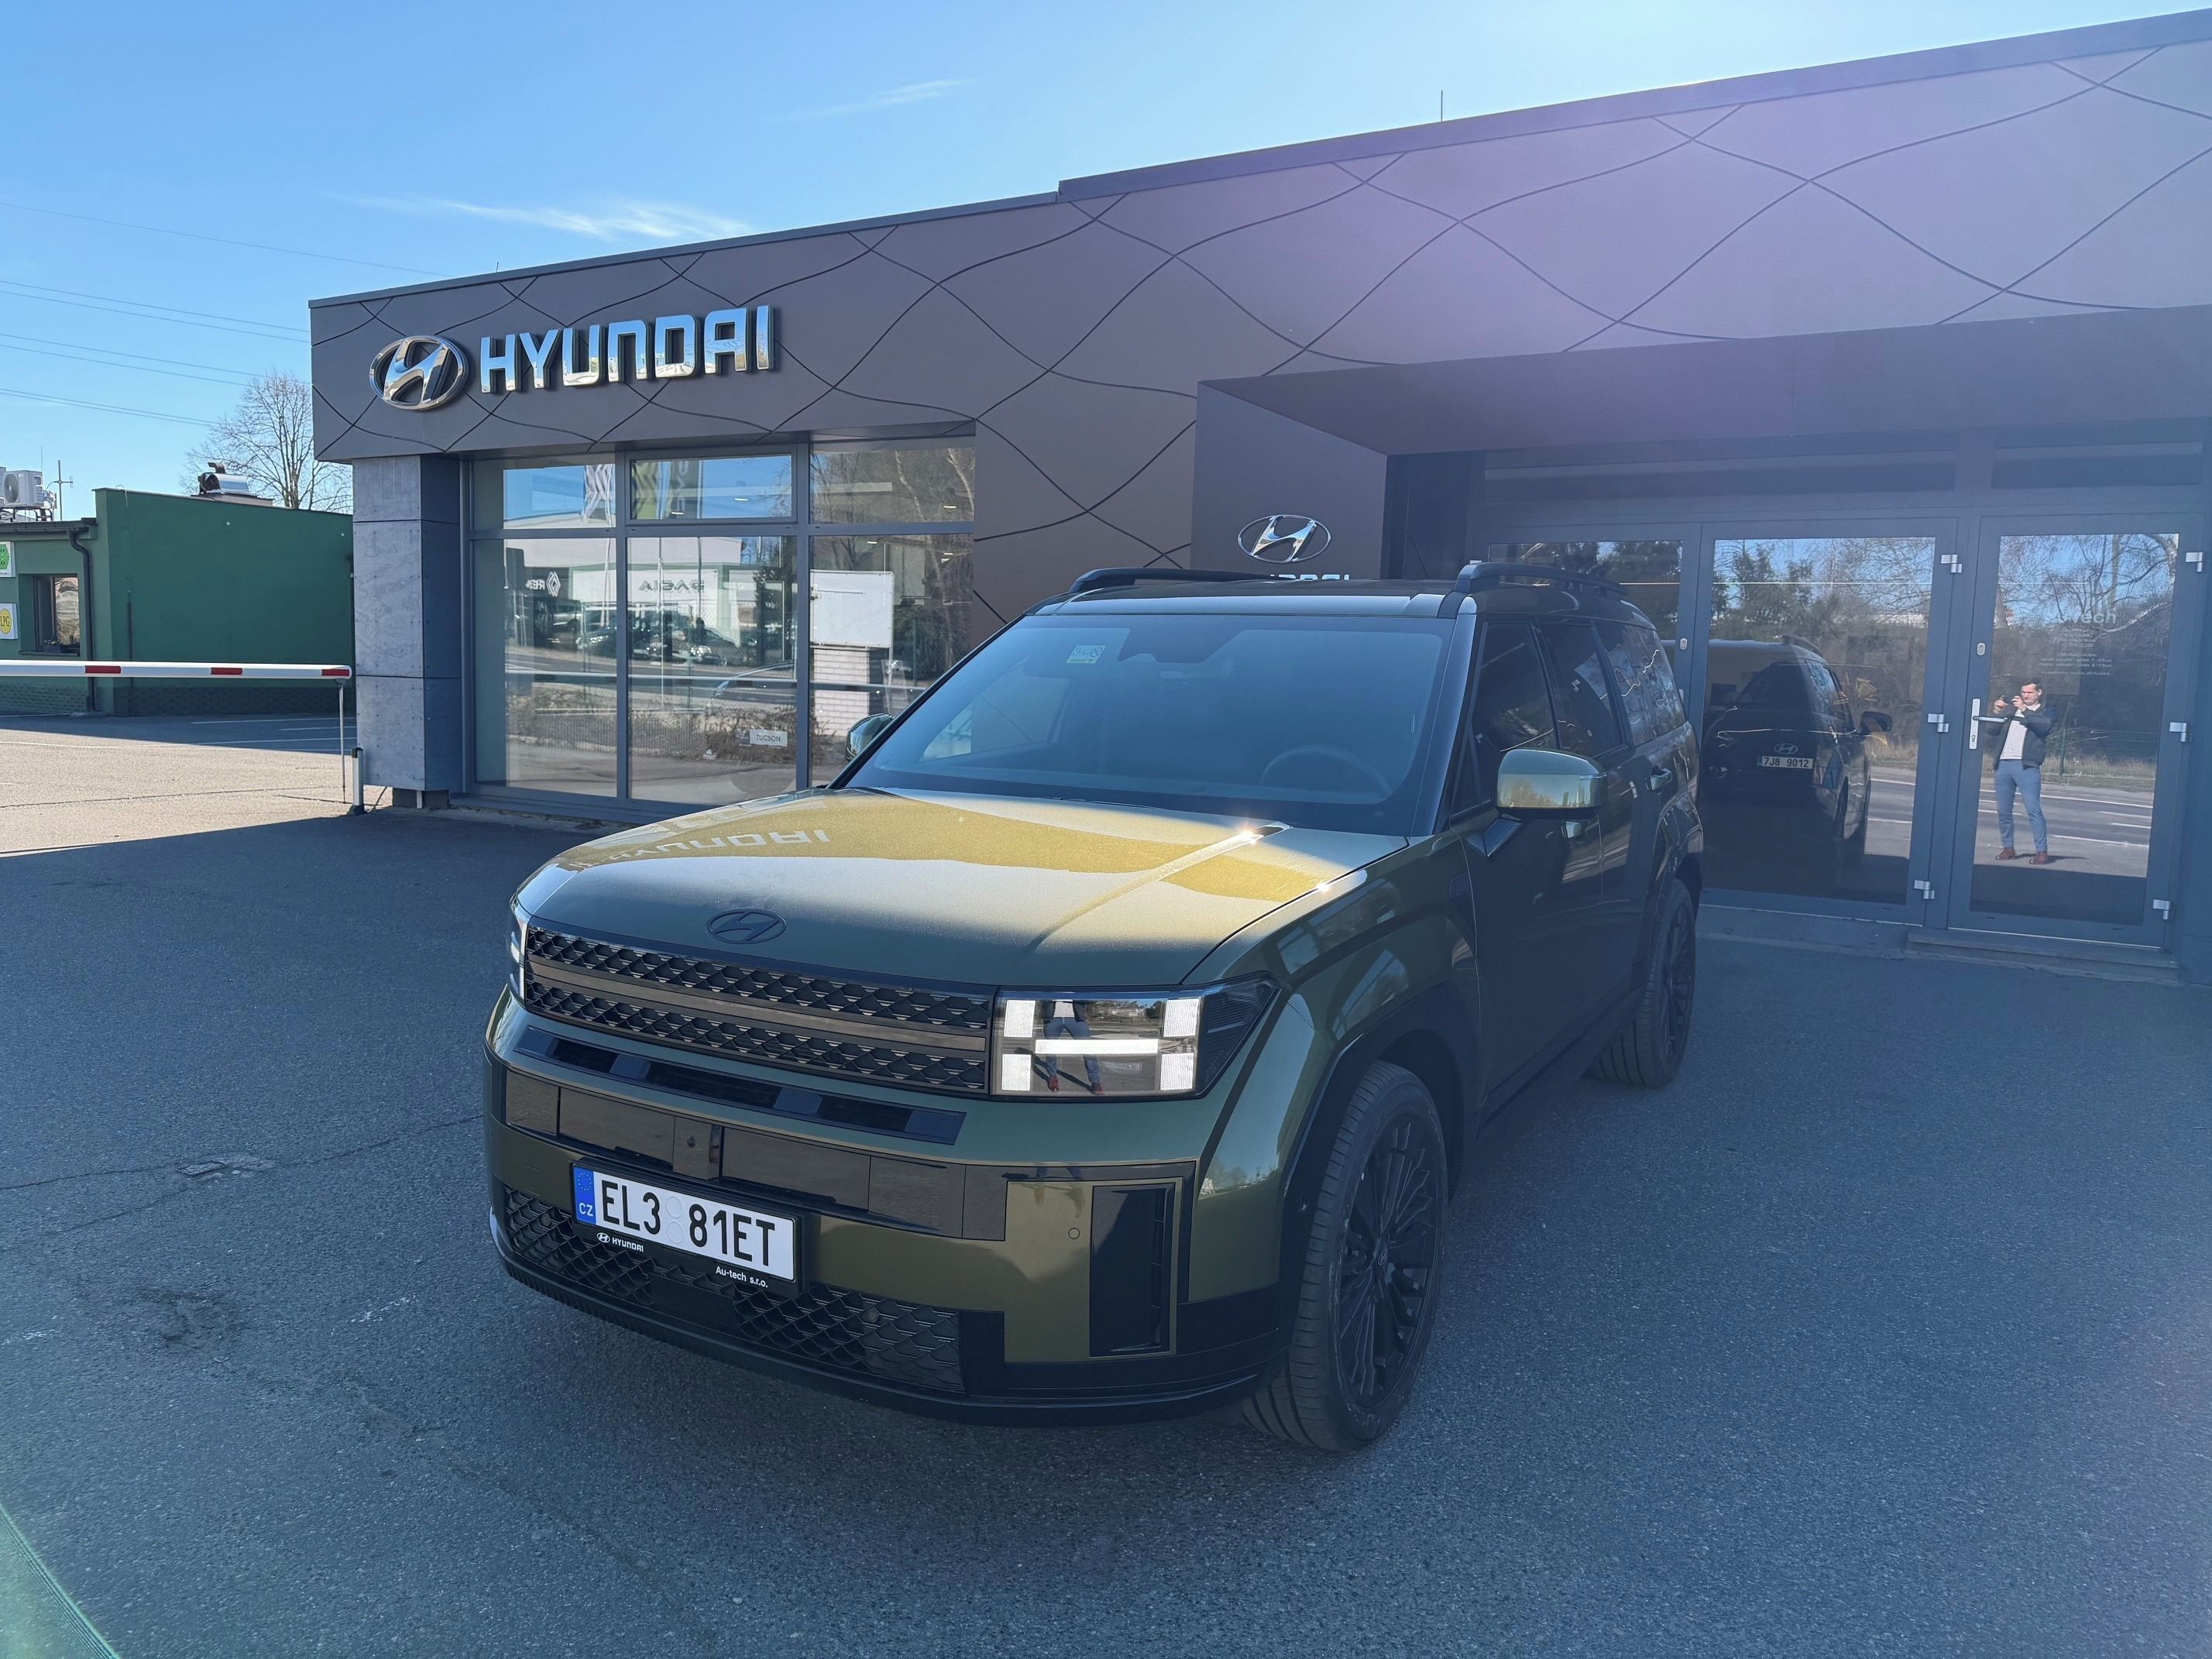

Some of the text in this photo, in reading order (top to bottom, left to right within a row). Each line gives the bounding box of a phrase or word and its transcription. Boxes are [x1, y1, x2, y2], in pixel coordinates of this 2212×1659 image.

[480, 305, 775, 394] HYUNDAI
[756, 733, 781, 742] TUCSON
[1764, 757, 1809, 768] 7J8 9012
[579, 1202, 594, 1217] CZ
[601, 1180, 775, 1267] EL3 81ET
[612, 1236, 644, 1253] HYUNDAI
[716, 1266, 768, 1288] Au-tech s.r.o.
